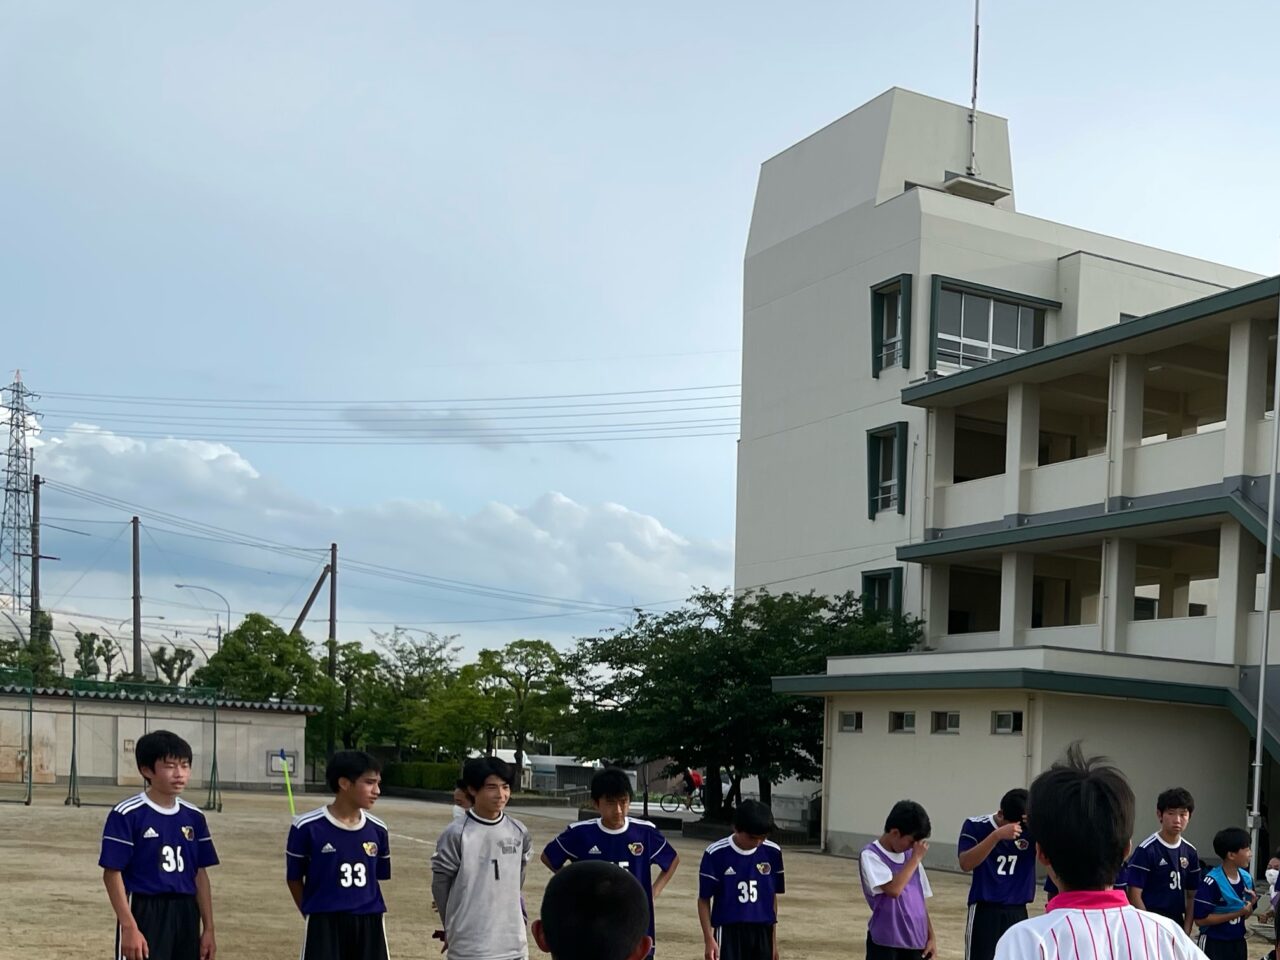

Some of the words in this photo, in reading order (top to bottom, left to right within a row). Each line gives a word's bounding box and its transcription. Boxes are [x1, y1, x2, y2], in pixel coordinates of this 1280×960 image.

[340, 862, 367, 888] 33
[491, 859, 500, 881] 1
[996, 855, 1018, 876] 27
[737, 880, 758, 903] 35
